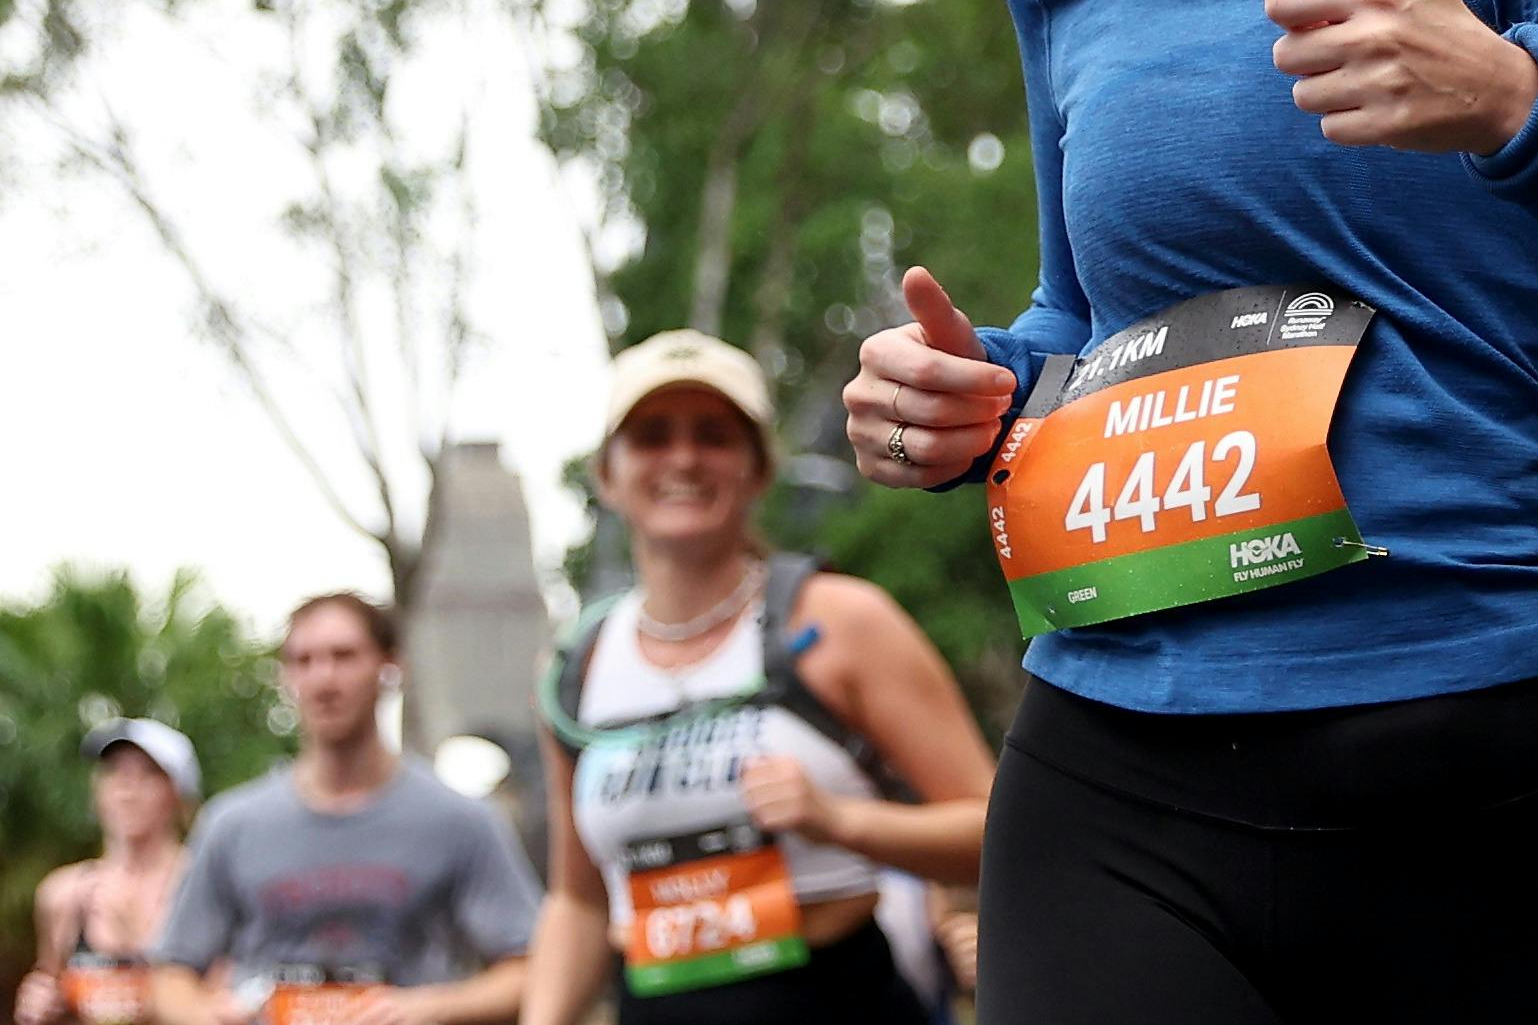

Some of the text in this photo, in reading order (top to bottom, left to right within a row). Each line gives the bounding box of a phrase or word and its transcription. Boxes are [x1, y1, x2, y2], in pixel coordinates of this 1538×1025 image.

[1231, 312, 1268, 329] HOKA
[1280, 324, 1308, 333] Sydney
[1282, 331, 1318, 340] Marathon
[1103, 375, 1240, 439] MILLIE
[1001, 422, 1033, 463] 4442
[1064, 430, 1262, 544] 4442
[992, 505, 1012, 559] 4442
[1229, 532, 1303, 569] HOKA
[1233, 558, 1305, 583] FLY HUMAN FLY
[1067, 586, 1098, 604] GREEN
